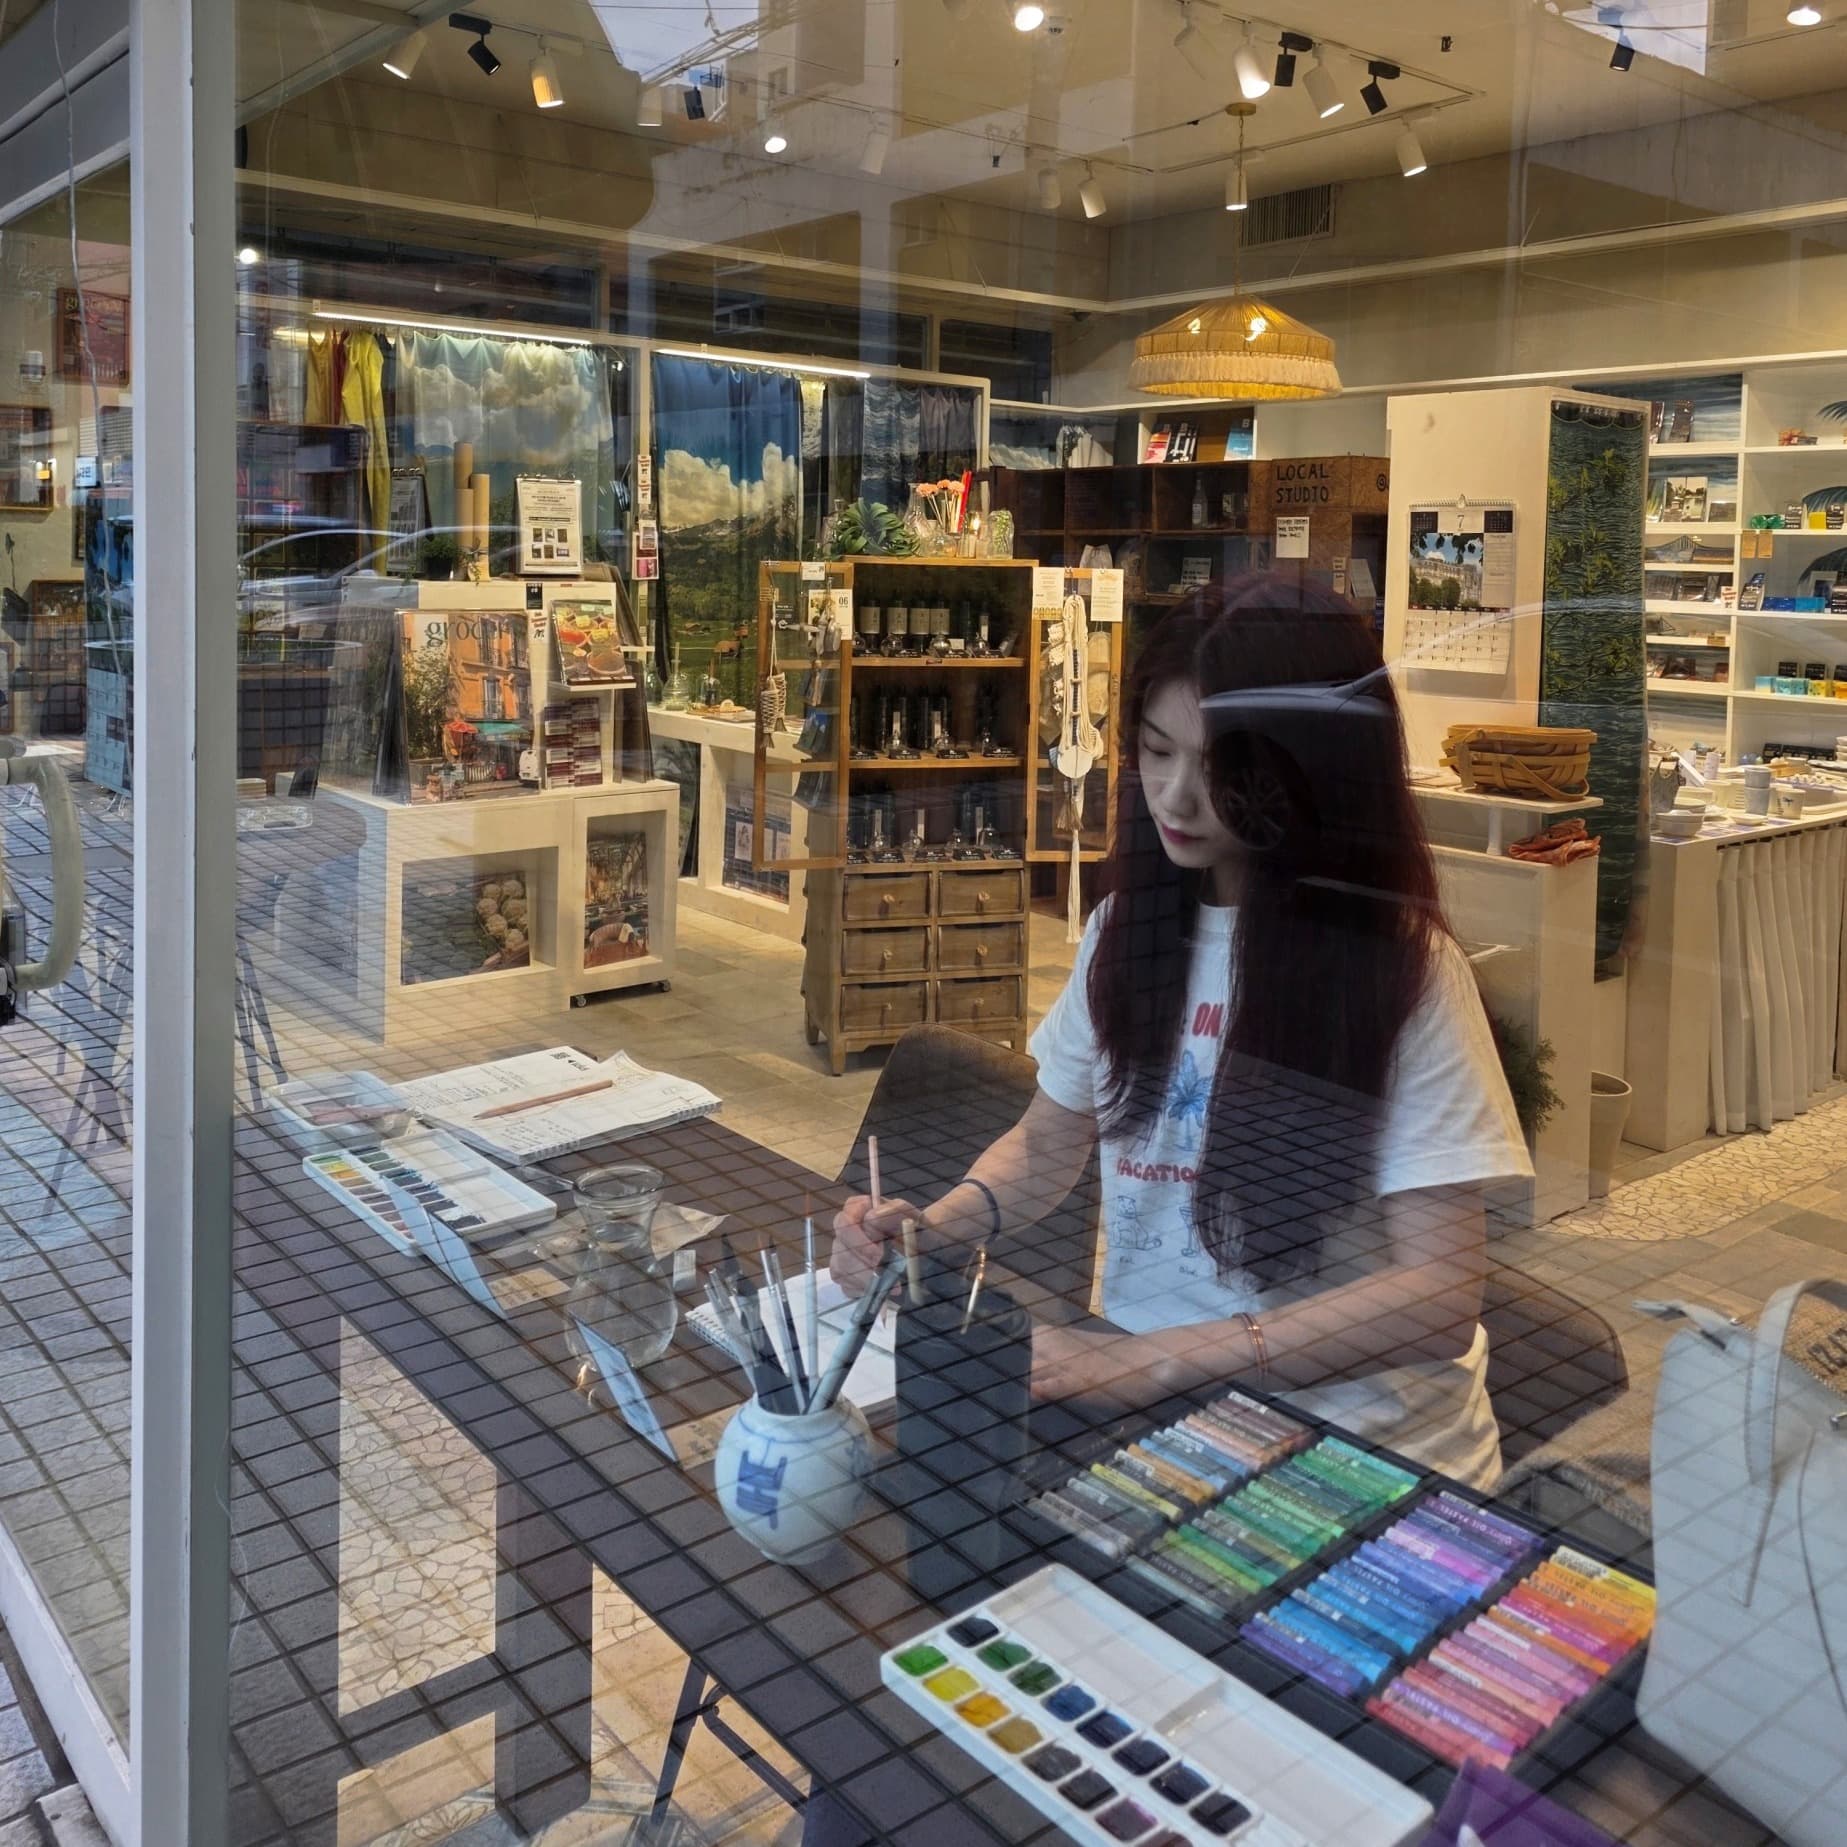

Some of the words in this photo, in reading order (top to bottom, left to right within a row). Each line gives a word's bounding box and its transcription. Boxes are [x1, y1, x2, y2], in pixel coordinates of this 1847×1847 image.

[1276, 463, 1330, 481] LOCAL
[1276, 485, 1330, 503] STUDIO
[1456, 514, 1465, 529] 7
[838, 596, 849, 605] 06
[1192, 1002, 1224, 1037] ON
[1117, 1158, 1198, 1184] ACATIO
